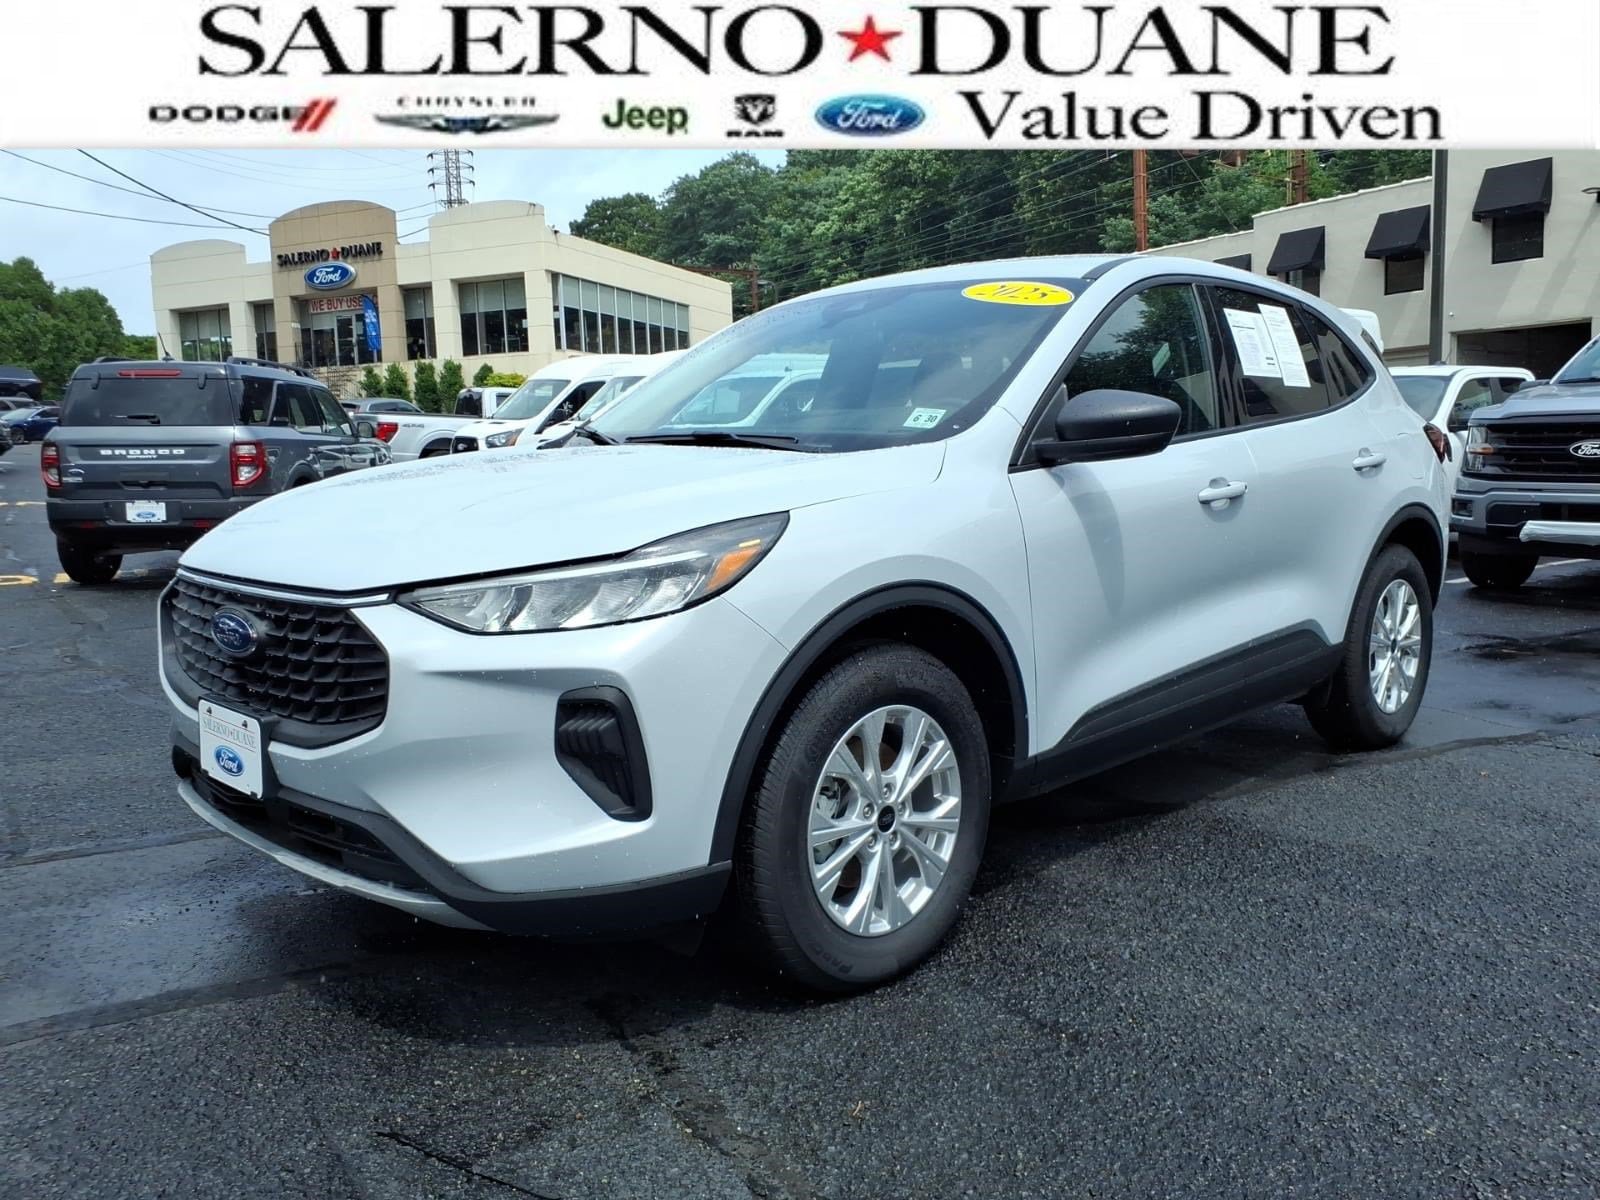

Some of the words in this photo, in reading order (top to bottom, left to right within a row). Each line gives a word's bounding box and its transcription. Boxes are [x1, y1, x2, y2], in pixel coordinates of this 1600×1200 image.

[277, 249, 330, 267] SALERNO
[341, 242, 383, 258] DUANE
[313, 266, 342, 284] Ford
[311, 299, 325, 312] WE
[326, 297, 346, 311] BUY
[346, 295, 363, 309] USE
[912, 414, 922, 423] 6
[1578, 443, 1600, 455] For
[219, 748, 239, 773] Ford
